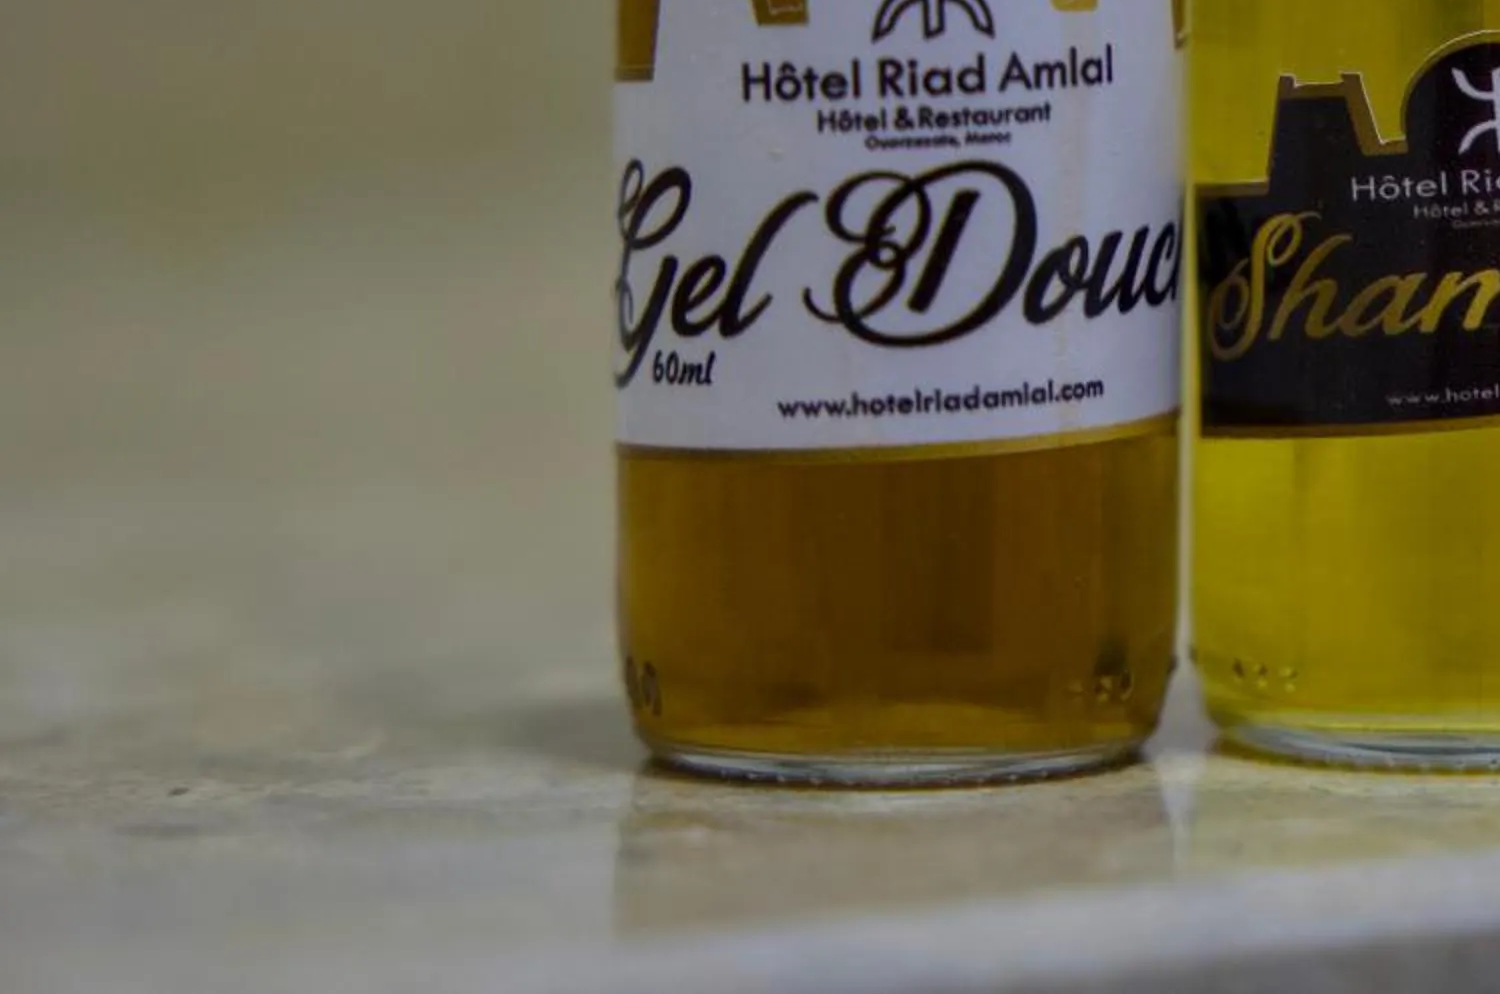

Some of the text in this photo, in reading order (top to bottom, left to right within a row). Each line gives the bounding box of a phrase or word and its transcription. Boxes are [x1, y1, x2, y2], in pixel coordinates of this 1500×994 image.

[742, 43, 1114, 102] Hôtel Riad Amlal
[817, 108, 887, 132] Hôtel
[1351, 169, 1448, 202] Hôtel
[1413, 201, 1469, 219] Hôtel
[615, 158, 1182, 389] Gel Douc
[653, 350, 717, 385] 60ml
[777, 378, 1104, 418] www.hotelriadamlal.com
